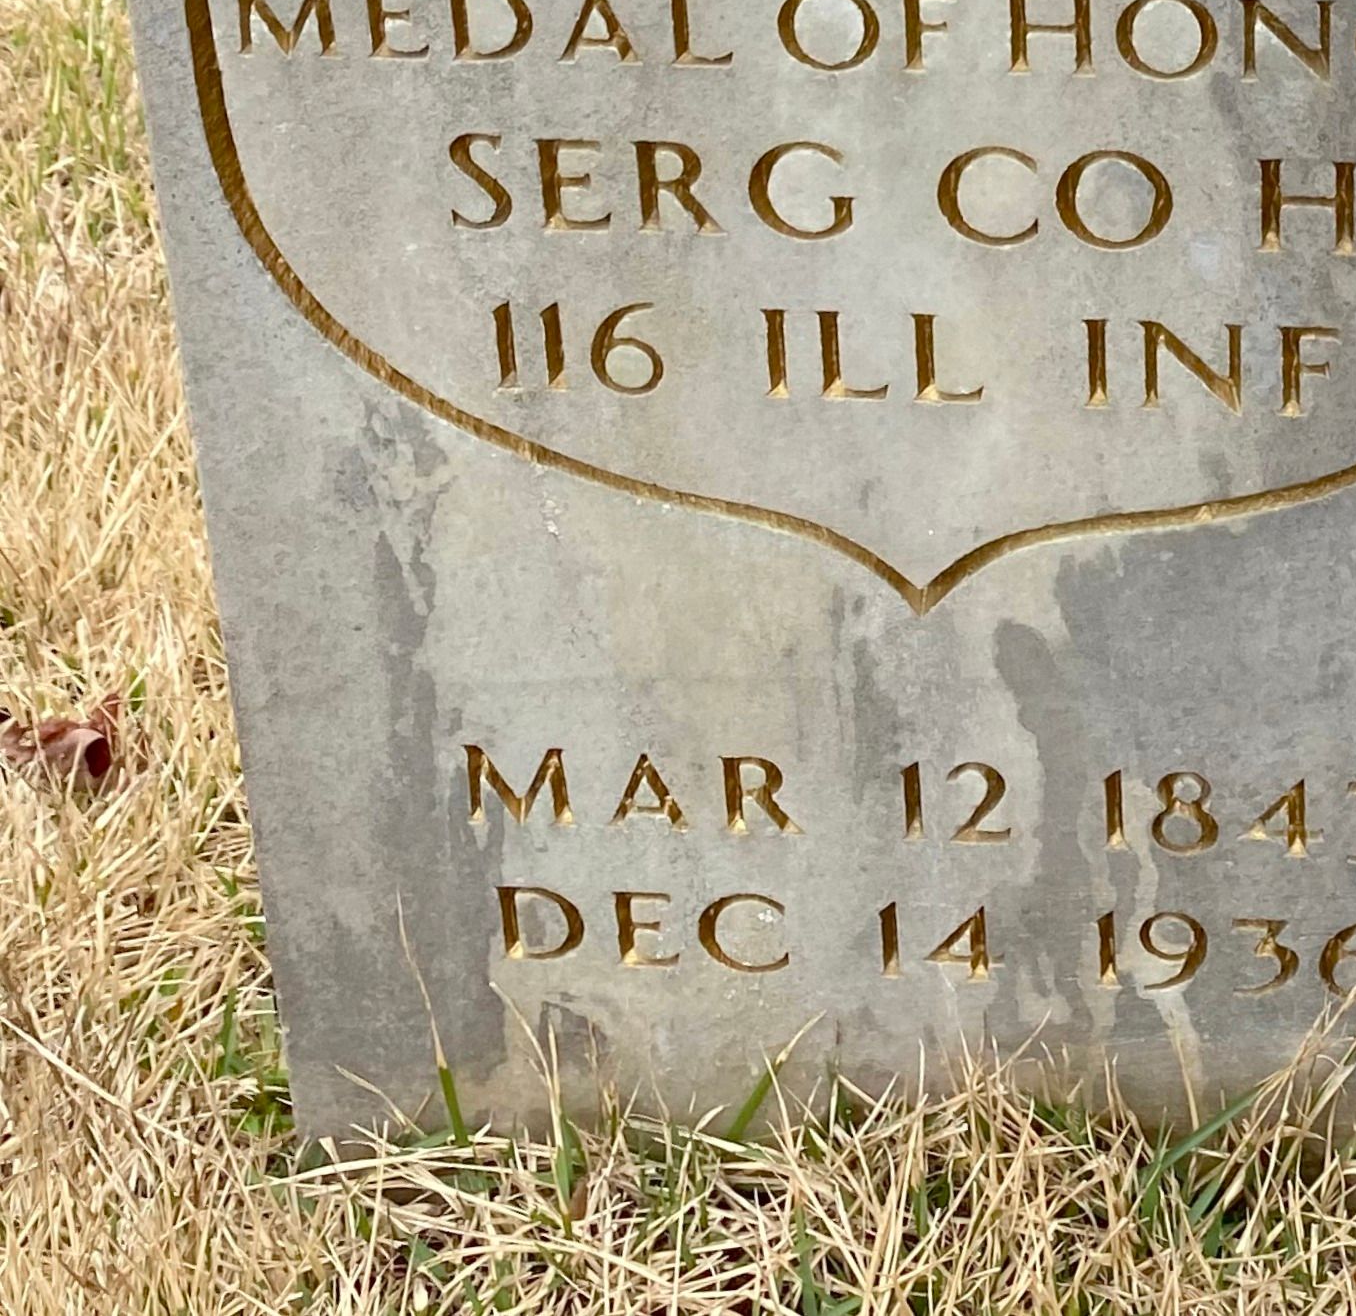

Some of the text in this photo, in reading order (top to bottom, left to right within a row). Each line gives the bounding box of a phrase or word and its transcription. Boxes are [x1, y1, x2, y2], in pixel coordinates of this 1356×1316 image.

[449, 133, 856, 240] SERG
[937, 145, 1174, 251] CO
[493, 301, 1341, 417] 116 ILL INF
[461, 744, 804, 835] MAR
[899, 760, 1012, 845] 12
[495, 885, 790, 973] DEC
[877, 900, 1004, 983] 14
